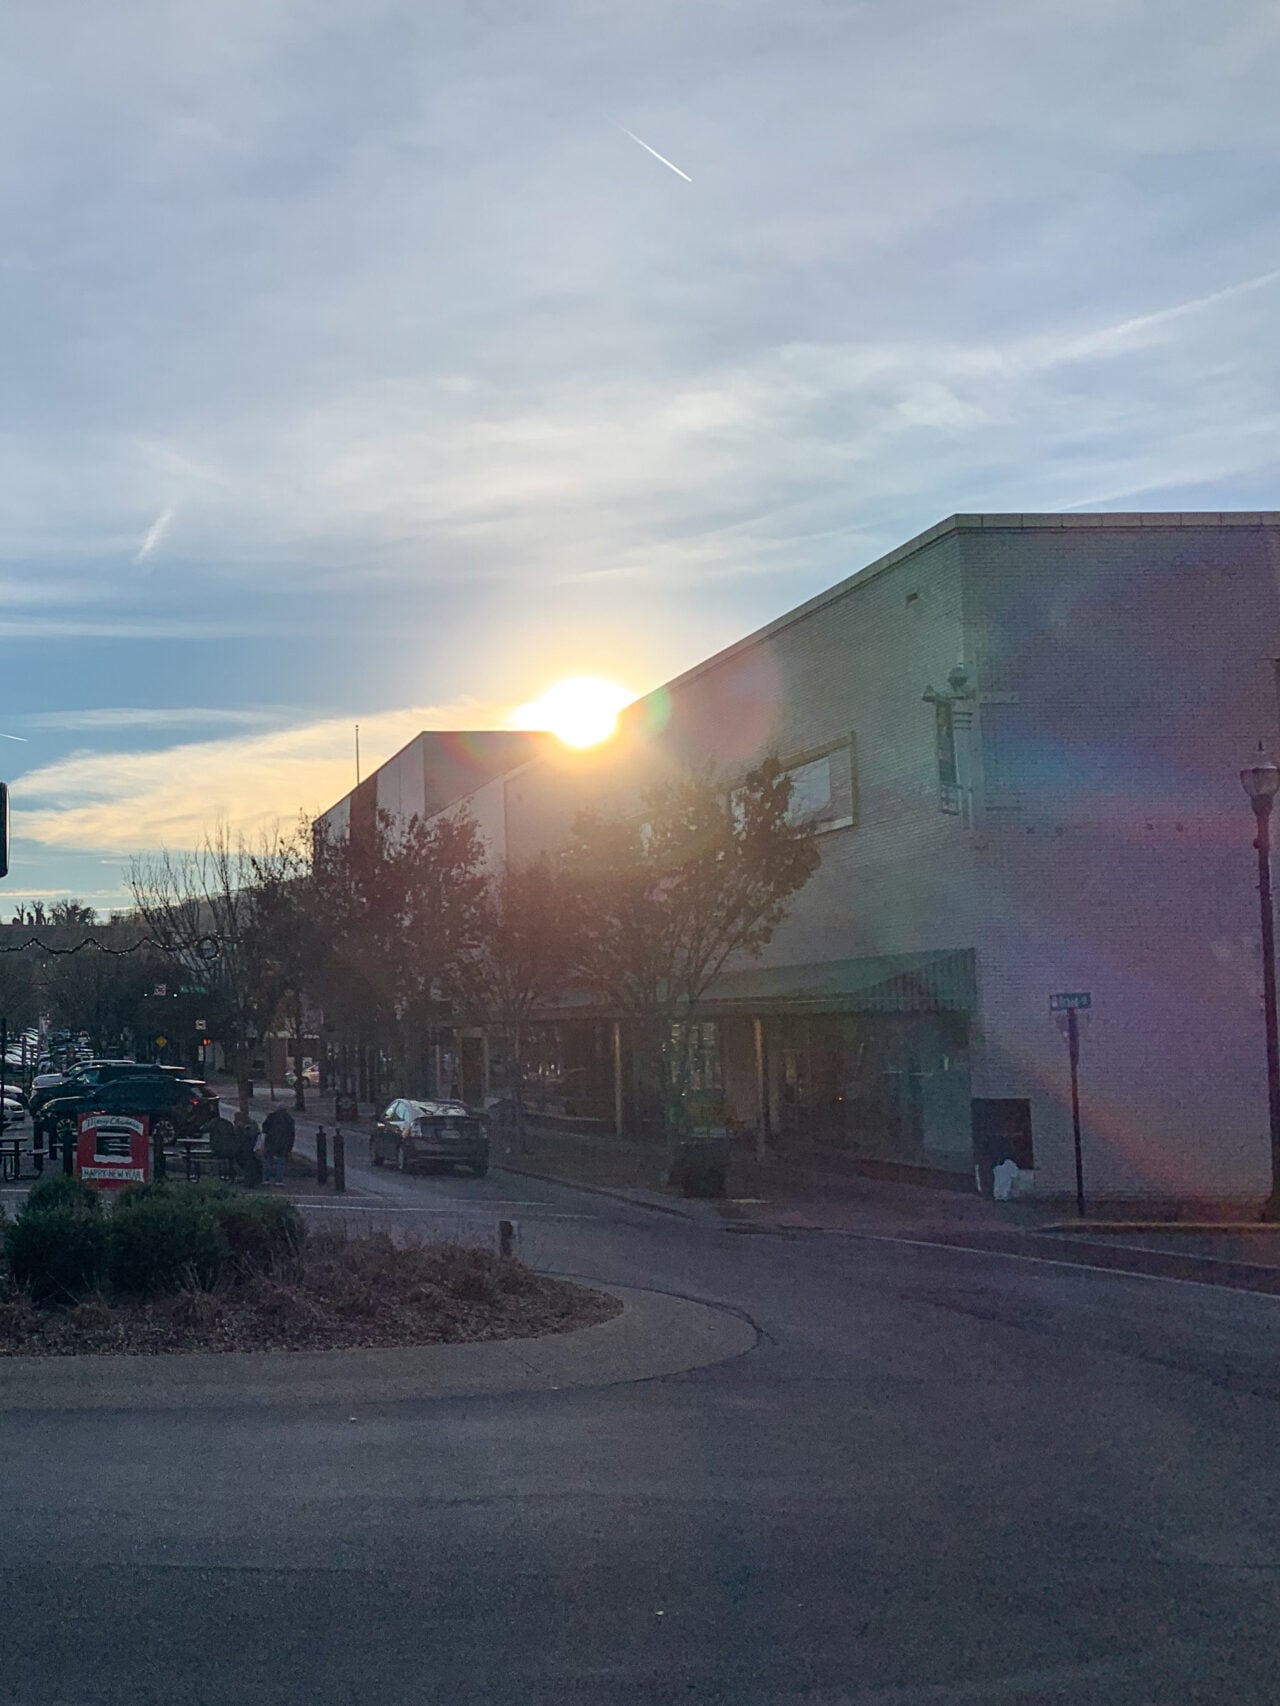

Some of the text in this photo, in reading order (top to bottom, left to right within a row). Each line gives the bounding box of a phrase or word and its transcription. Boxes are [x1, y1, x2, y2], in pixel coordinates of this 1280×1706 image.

[83, 1168, 141, 1179] HAPPY NEW YEAR
